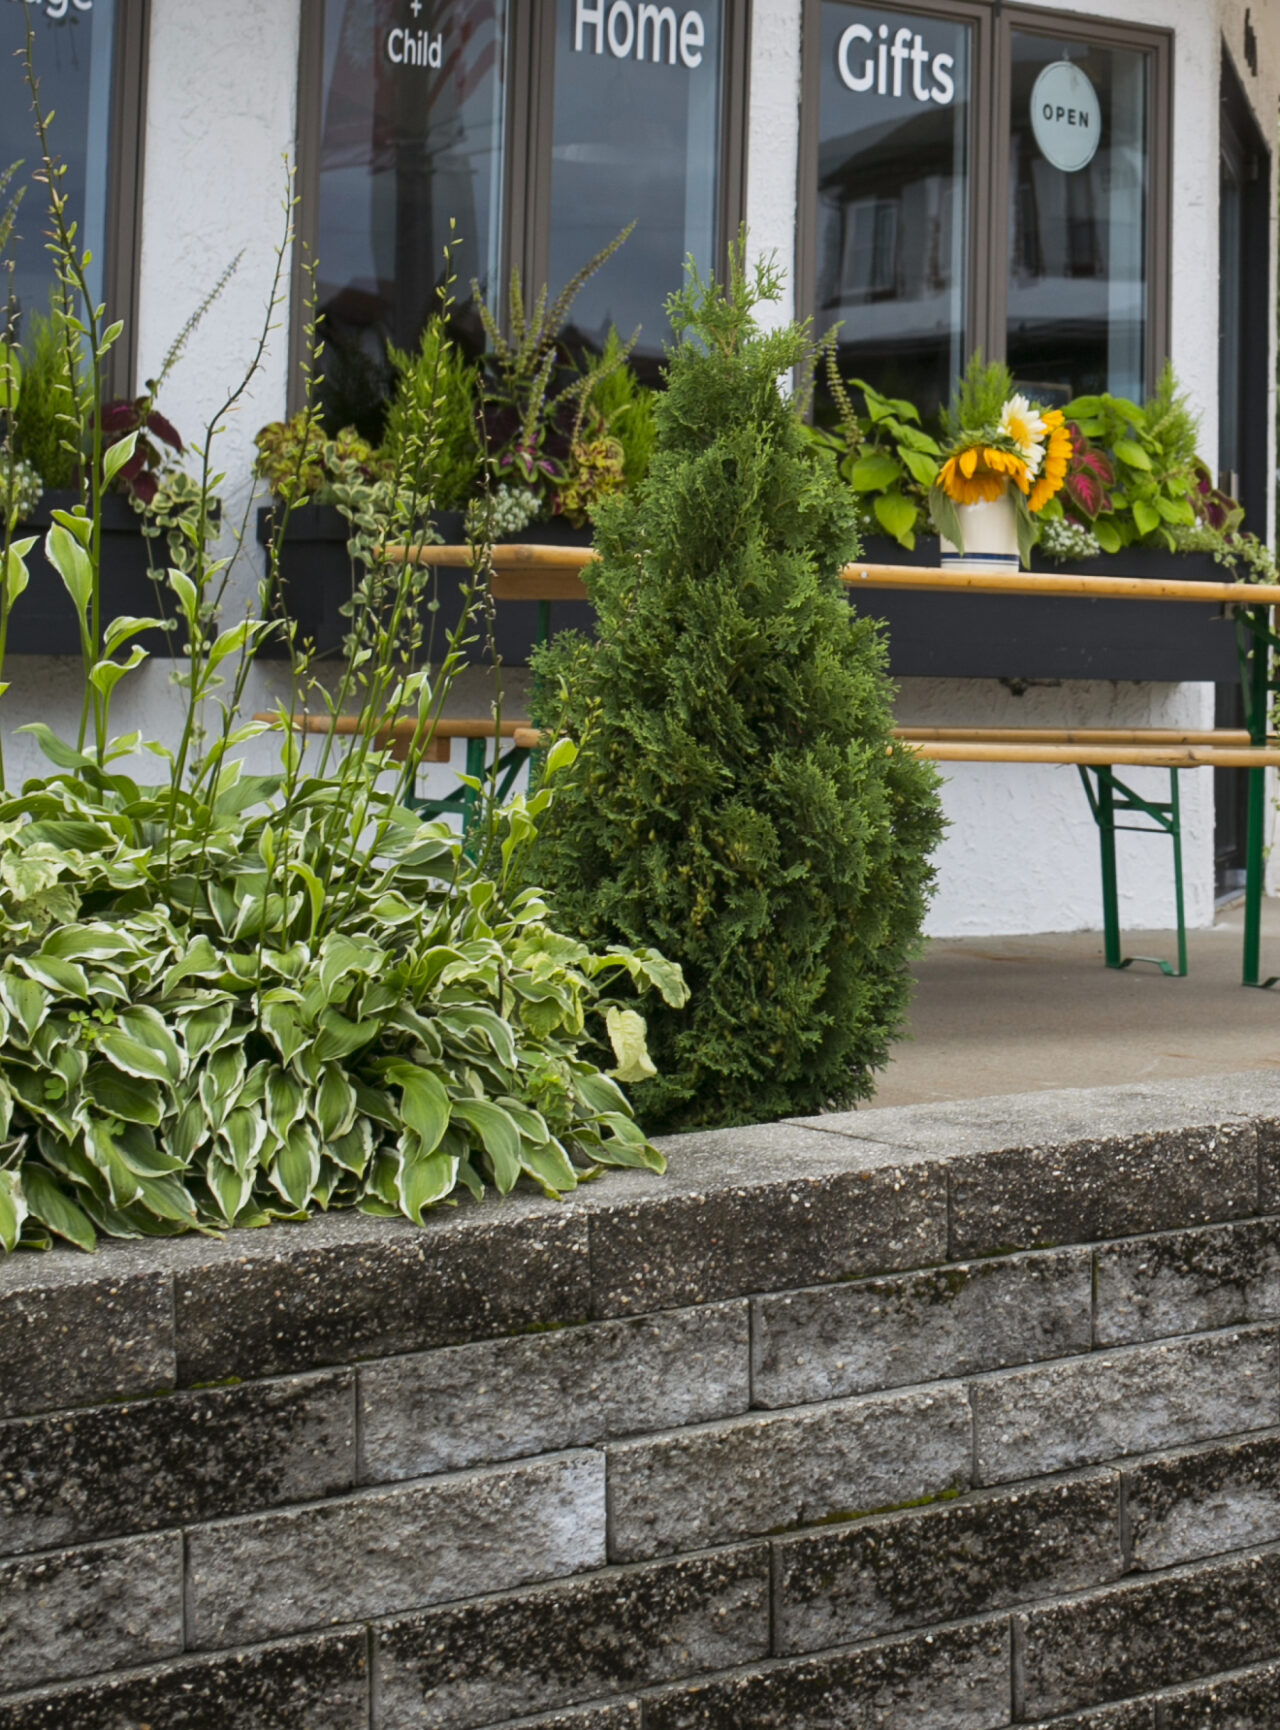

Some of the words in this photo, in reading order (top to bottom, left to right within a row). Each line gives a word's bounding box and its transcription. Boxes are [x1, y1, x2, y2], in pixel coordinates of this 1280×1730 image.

[387, 27, 442, 68] Child
[575, 0, 705, 68] Home
[838, 23, 955, 104] Gifts
[1042, 104, 1089, 128] OPEN
